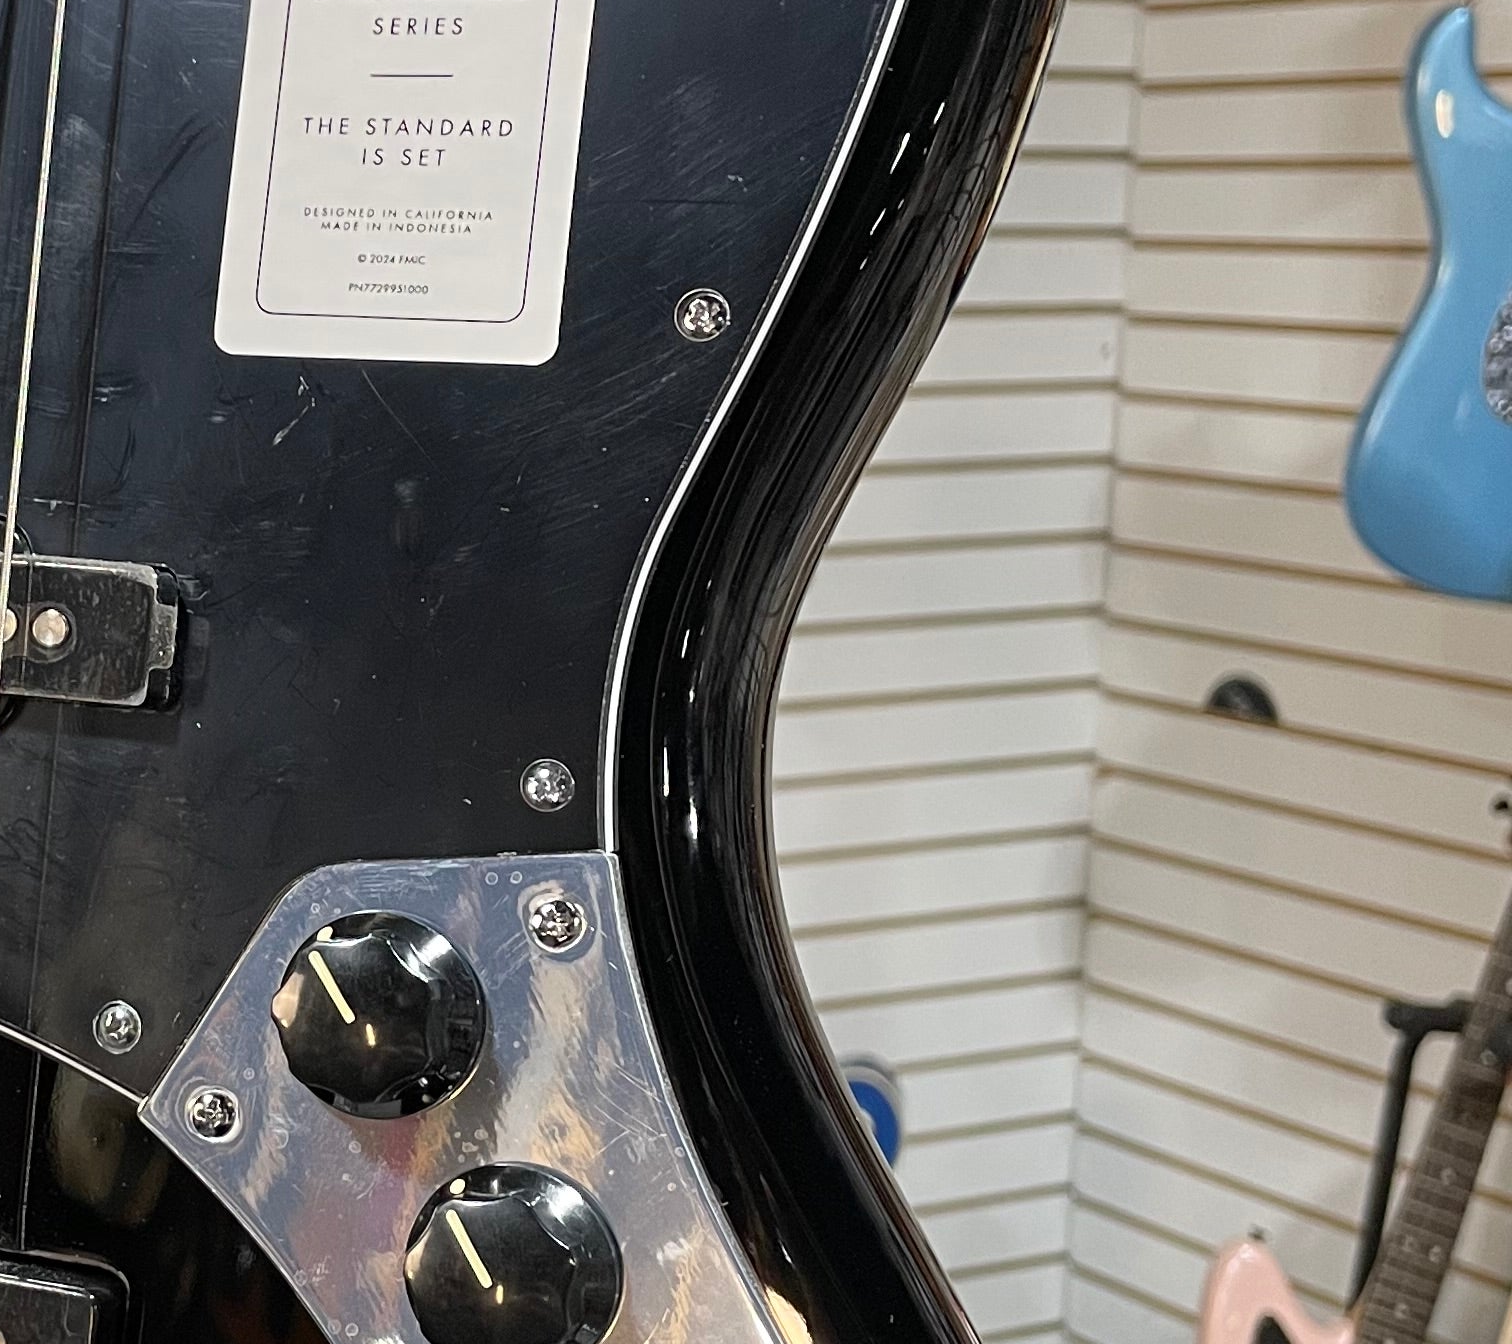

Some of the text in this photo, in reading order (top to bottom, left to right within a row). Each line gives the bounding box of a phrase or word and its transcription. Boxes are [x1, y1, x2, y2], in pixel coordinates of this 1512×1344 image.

[372, 16, 464, 36] SERIES
[303, 116, 513, 137] THE STANDARD
[361, 147, 446, 167] IS SET
[303, 206, 493, 221] DESIGNED IN CALIFORNIA
[320, 221, 472, 234] MADE IN INDONESIA
[369, 254, 396, 265] 2024
